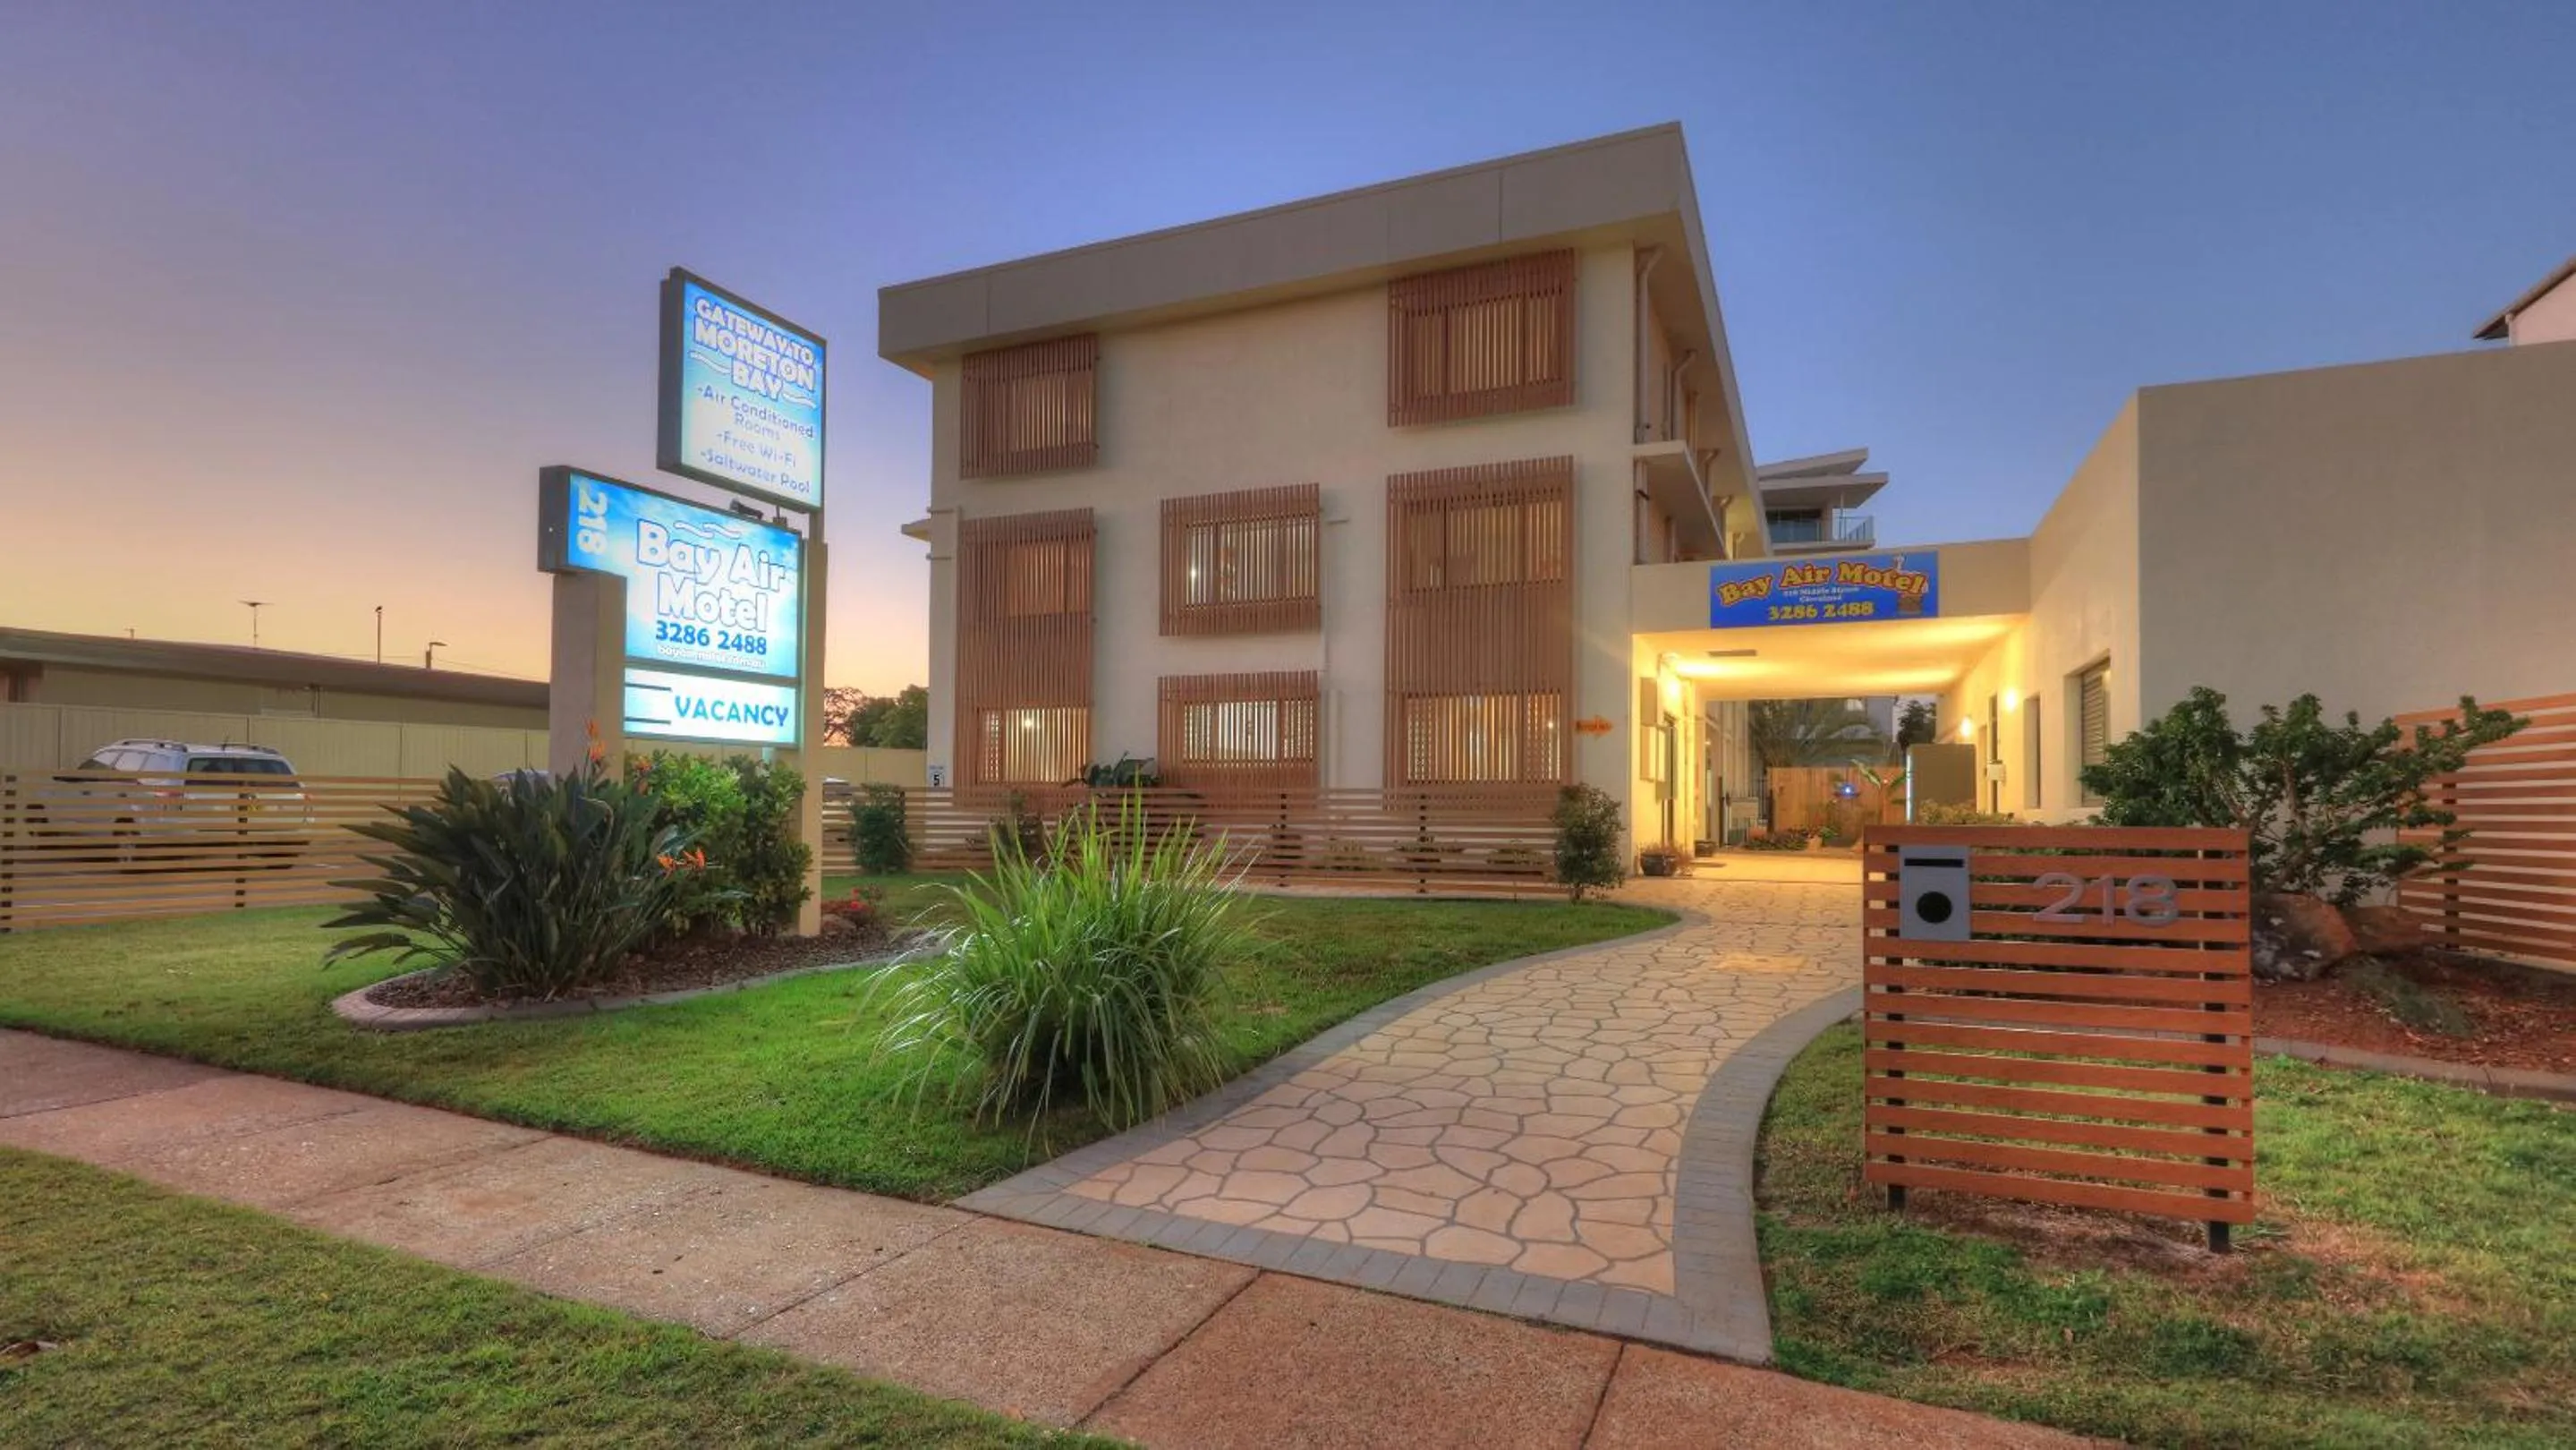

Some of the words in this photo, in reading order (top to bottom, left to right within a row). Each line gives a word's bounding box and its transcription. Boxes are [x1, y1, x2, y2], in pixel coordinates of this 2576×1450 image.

[693, 315, 816, 392] MORETON
[695, 297, 788, 356] GATEWAY
[788, 339, 815, 368] TO
[731, 356, 783, 401] BAY
[731, 396, 813, 439] Conditioned
[735, 413, 780, 440] Rooms
[780, 473, 810, 492] Pool
[577, 484, 608, 557] 218
[637, 518, 721, 585] Bay
[728, 542, 787, 592] Air
[657, 571, 768, 632] Motel
[1718, 575, 1773, 606] Bay
[1780, 563, 1831, 587] Air
[1837, 562, 1926, 595] Motel
[1768, 604, 1818, 620] 3286
[1823, 601, 1875, 618] 2488
[656, 620, 710, 646] 3286
[718, 629, 767, 655] 2488
[675, 695, 788, 727] VACANCY
[934, 774, 939, 787] 5
[2033, 872, 2180, 927] 218
